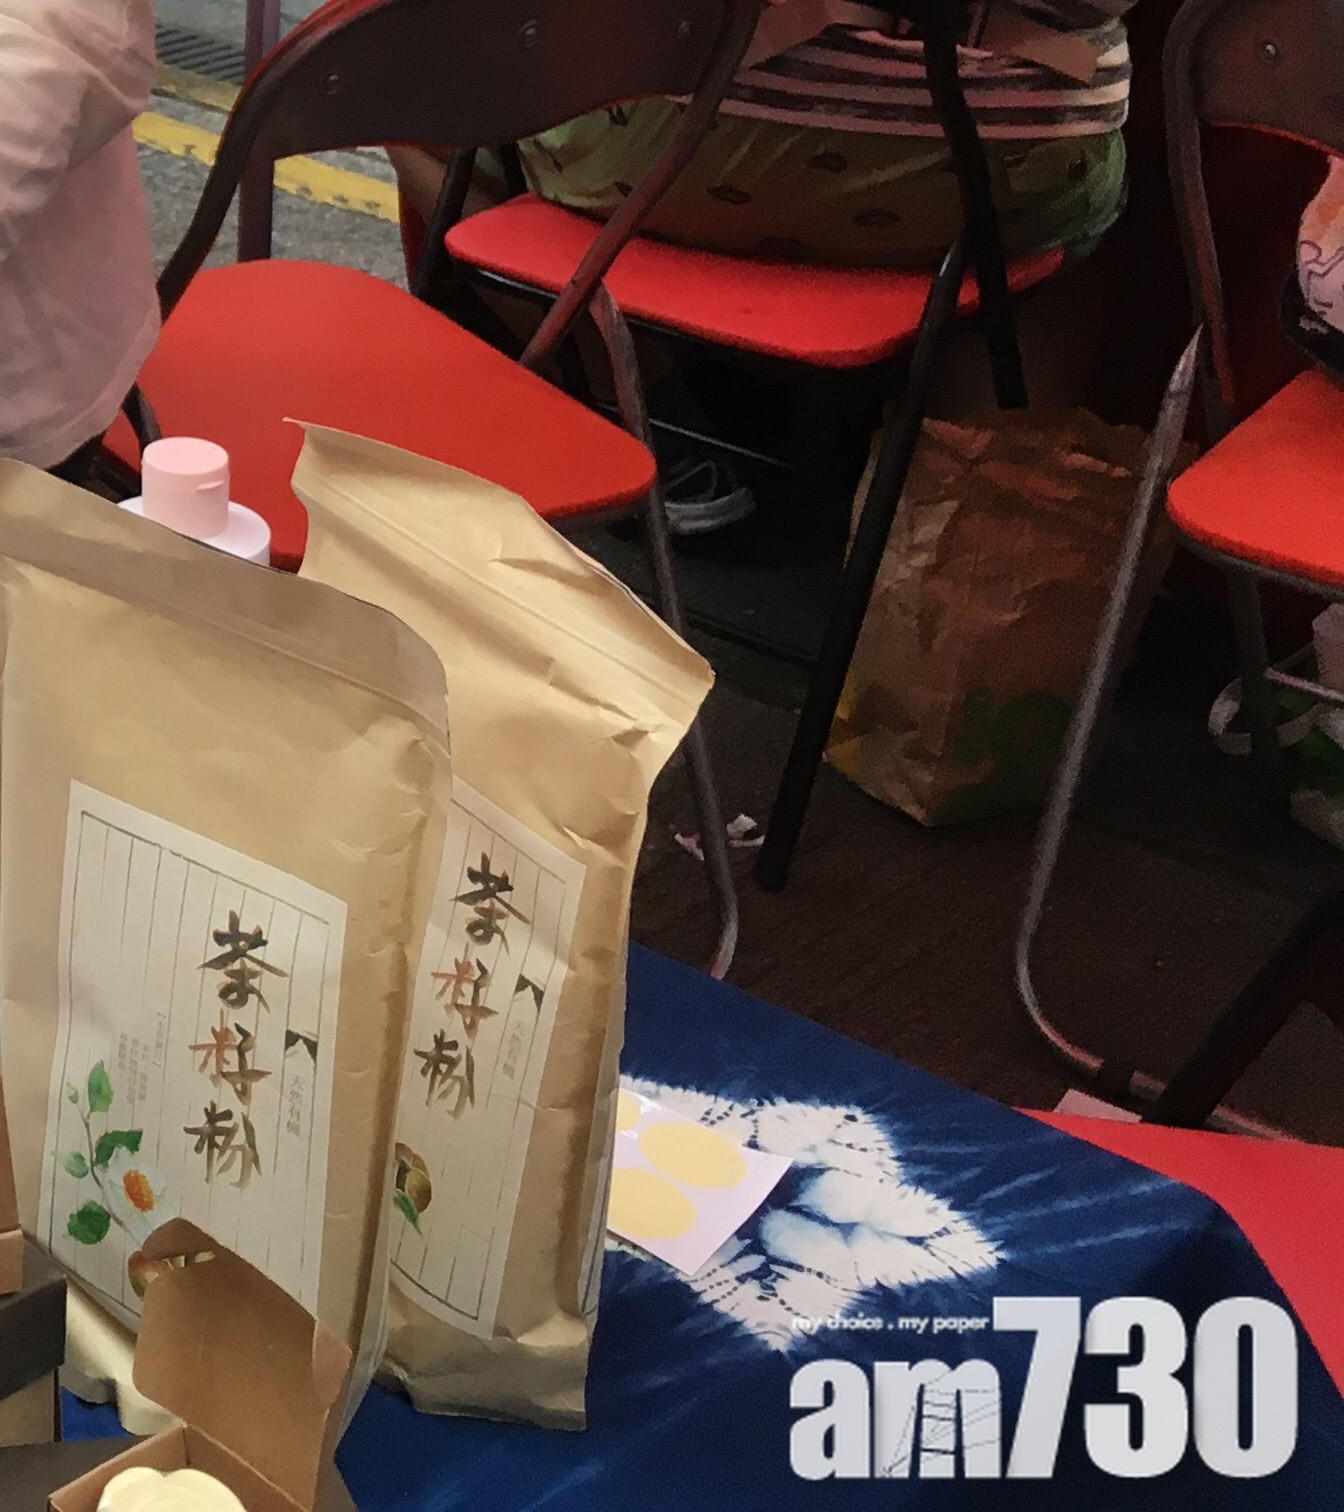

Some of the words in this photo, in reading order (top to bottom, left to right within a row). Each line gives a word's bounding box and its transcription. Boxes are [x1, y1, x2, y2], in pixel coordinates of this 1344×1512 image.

[183, 909, 289, 1189] 茶籽粉
[413, 851, 531, 1120] 茶籽粉
